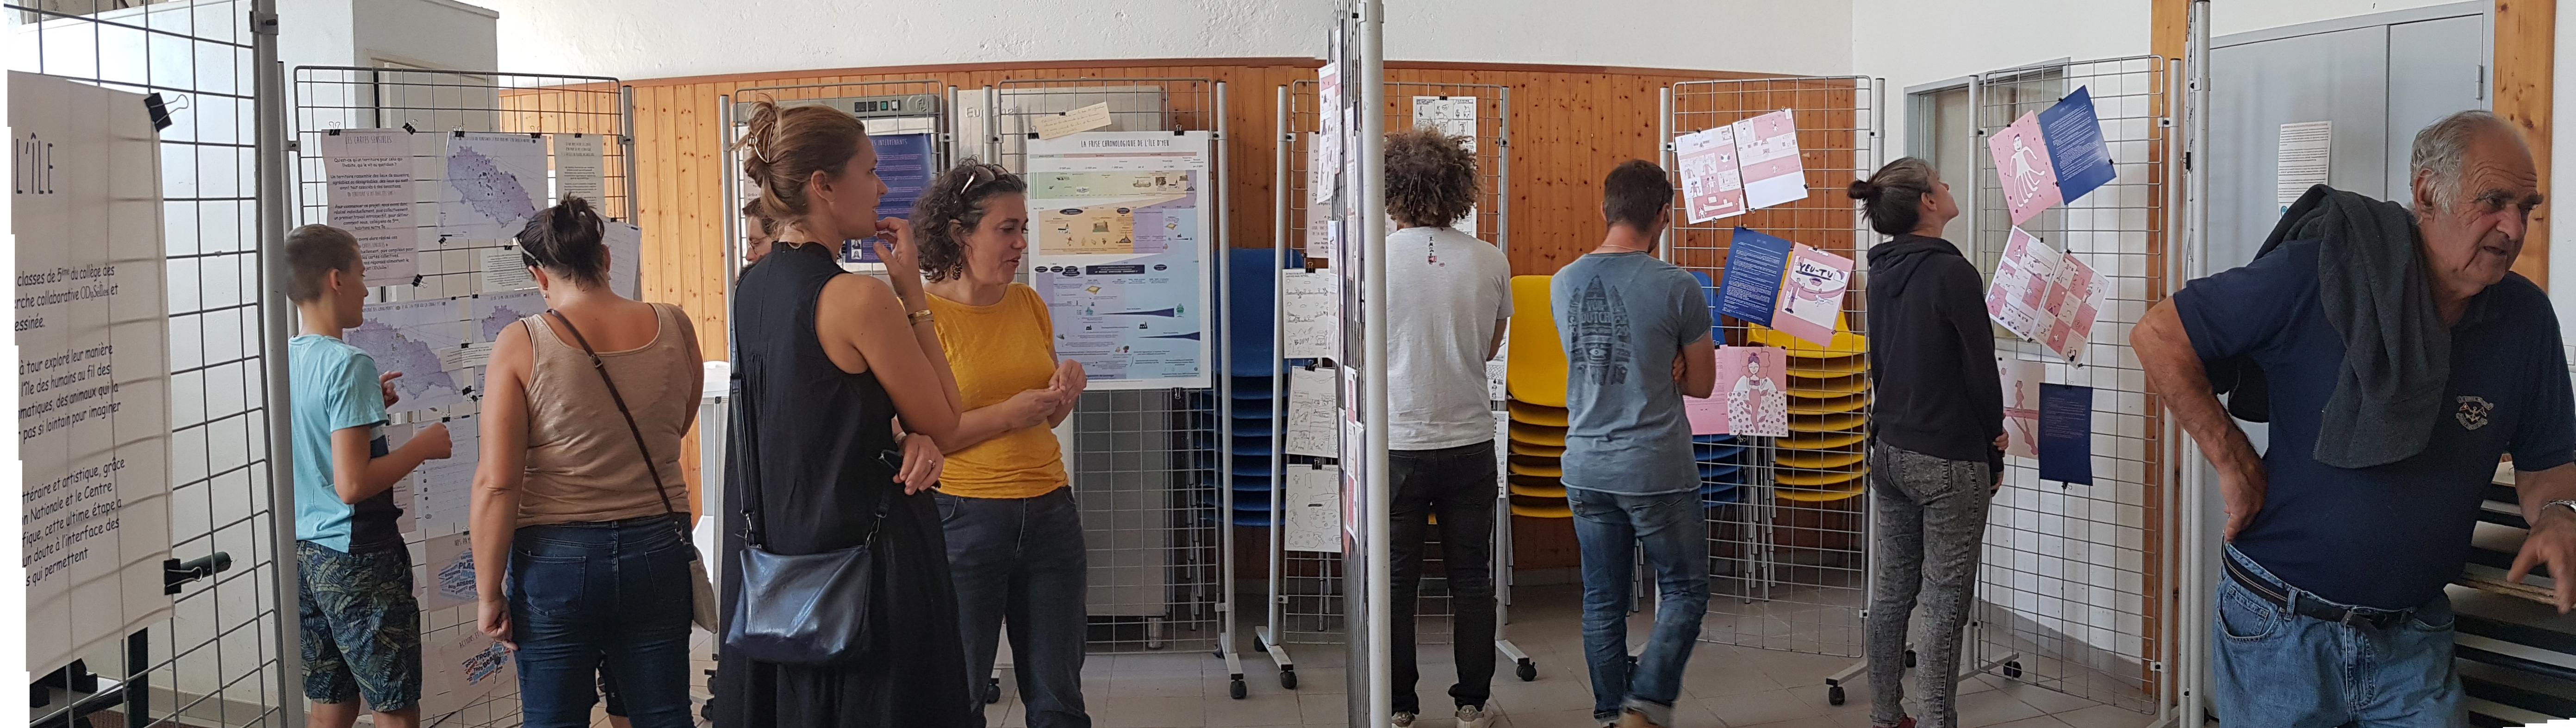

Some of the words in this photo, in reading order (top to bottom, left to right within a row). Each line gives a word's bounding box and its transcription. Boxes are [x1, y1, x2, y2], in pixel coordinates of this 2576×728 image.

[371, 136, 392, 144] SENSIBLES
[16, 132, 53, 194] L'ÎLE
[17, 271, 45, 287] classes
[47, 269, 55, 283] de
[71, 266, 78, 280] du
[80, 264, 101, 281] collège
[103, 263, 115, 276] des
[37, 288, 79, 306] collaborative
[111, 283, 118, 295] et
[19, 360, 24, 375] à
[27, 358, 43, 374] tour
[45, 349, 69, 372] exploré
[71, 349, 83, 363] leur
[85, 342, 113, 359] manière
[37, 378, 49, 393] des
[51, 371, 76, 389] humains
[78, 370, 85, 381] au
[97, 363, 111, 376] des
[56, 394, 68, 408] des
[69, 388, 96, 404] animaux
[98, 382, 109, 399] qui
[24, 426, 36, 444] pas
[38, 420, 44, 435] si
[46, 413, 70, 433] lointain
[72, 410, 87, 428] pour
[89, 401, 121, 419] imaginer
[53, 478, 61, 491] et
[62, 467, 101, 488] artistique,
[103, 457, 125, 477] grâce
[31, 496, 64, 523] Nationale
[66, 493, 73, 507] et
[75, 489, 82, 502] le
[84, 483, 112, 499] Centre
[45, 519, 64, 536] cette
[66, 510, 89, 527] ultime
[92, 502, 115, 520] étape
[117, 498, 122, 508] a
[34, 546, 54, 562] doute
[55, 537, 60, 551] à
[62, 525, 104, 549] l'interface
[106, 518, 119, 532] des
[32, 567, 43, 587] qui
[44, 547, 89, 581] permettent
